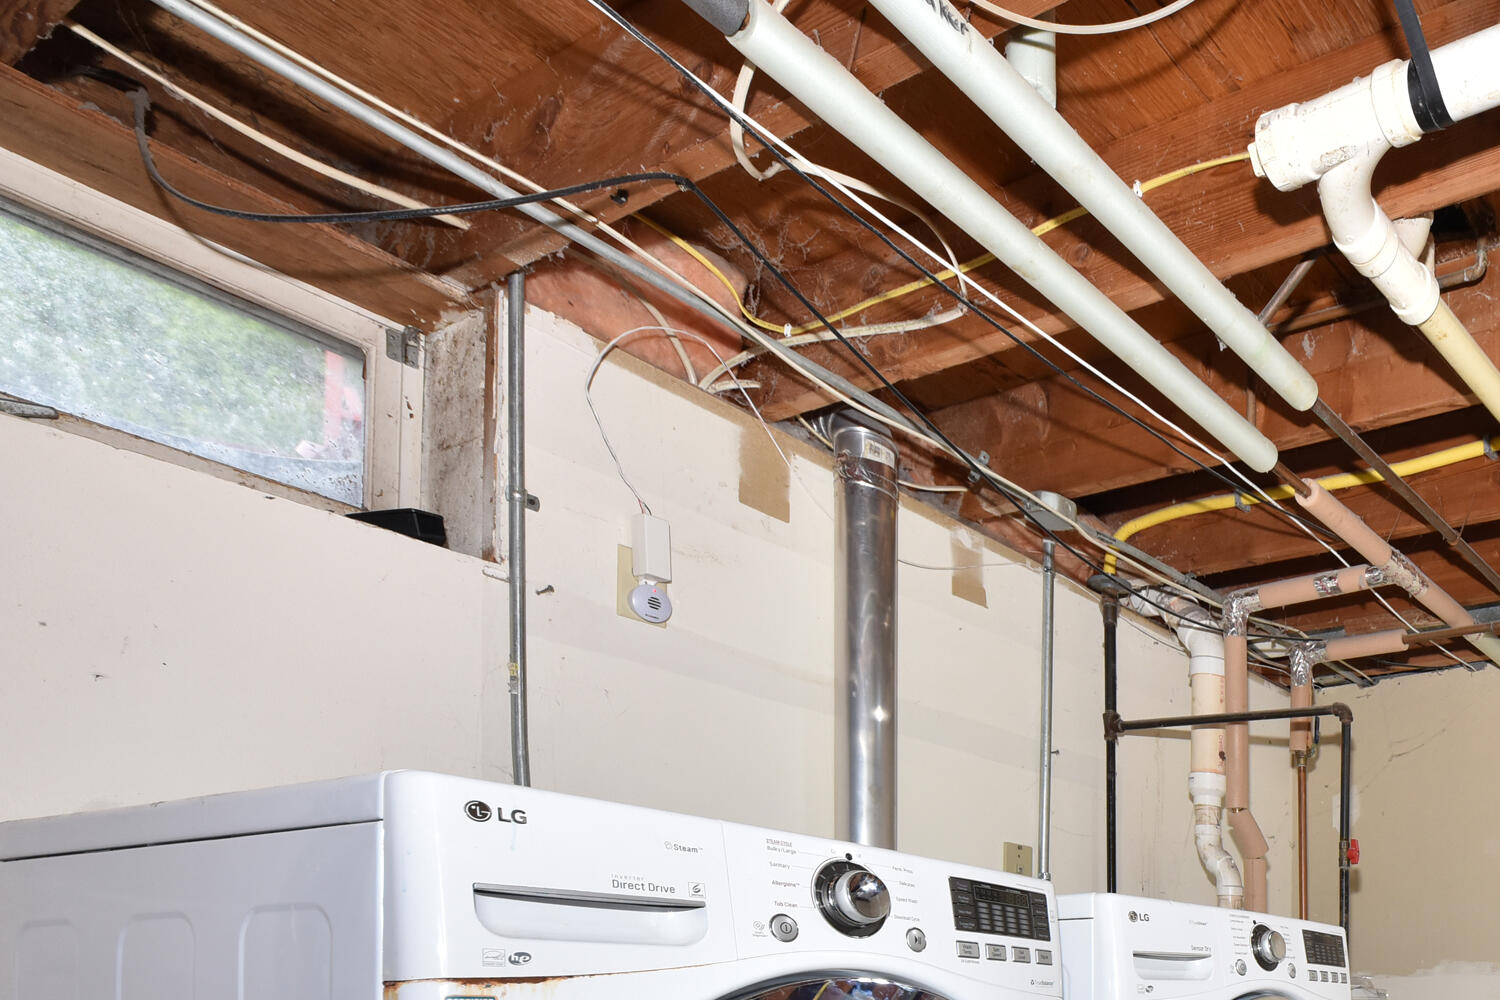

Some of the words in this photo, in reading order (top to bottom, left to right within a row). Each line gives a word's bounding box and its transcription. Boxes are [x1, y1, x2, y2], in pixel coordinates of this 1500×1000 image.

[498, 807, 528, 825] LG
[612, 879, 646, 891] Direct
[648, 883, 676, 894] Drive
